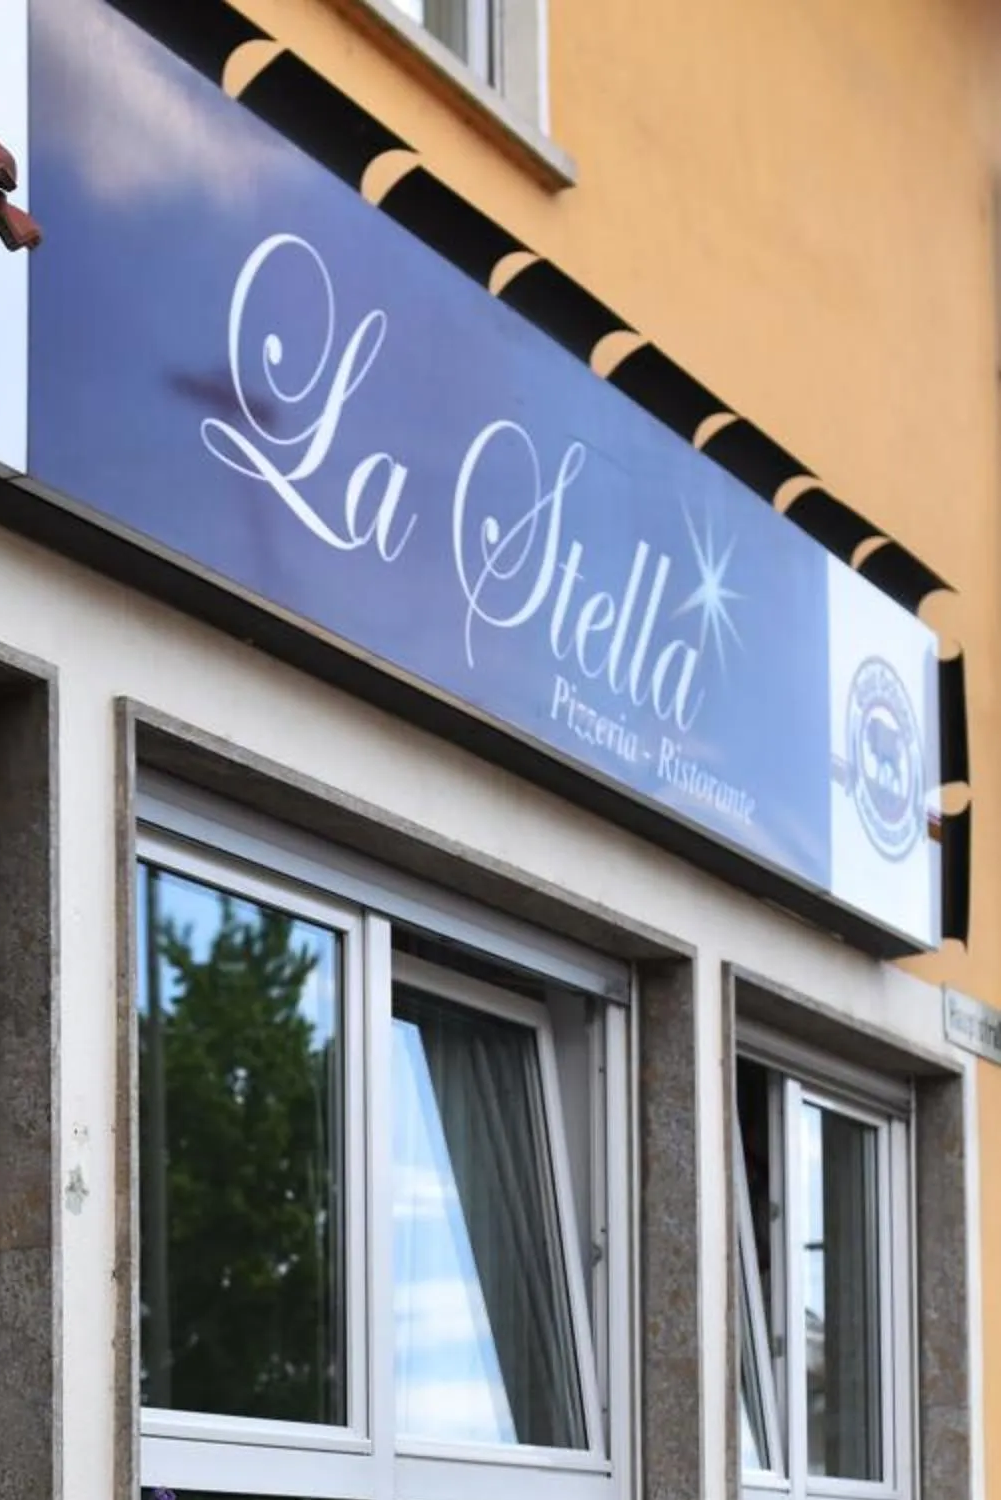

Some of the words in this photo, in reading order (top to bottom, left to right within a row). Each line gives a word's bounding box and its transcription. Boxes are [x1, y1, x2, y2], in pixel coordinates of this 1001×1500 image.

[201, 233, 417, 562] La
[453, 420, 706, 731] Stella
[550, 674, 639, 762] Pizzeria
[657, 736, 757, 825] Ristorante
